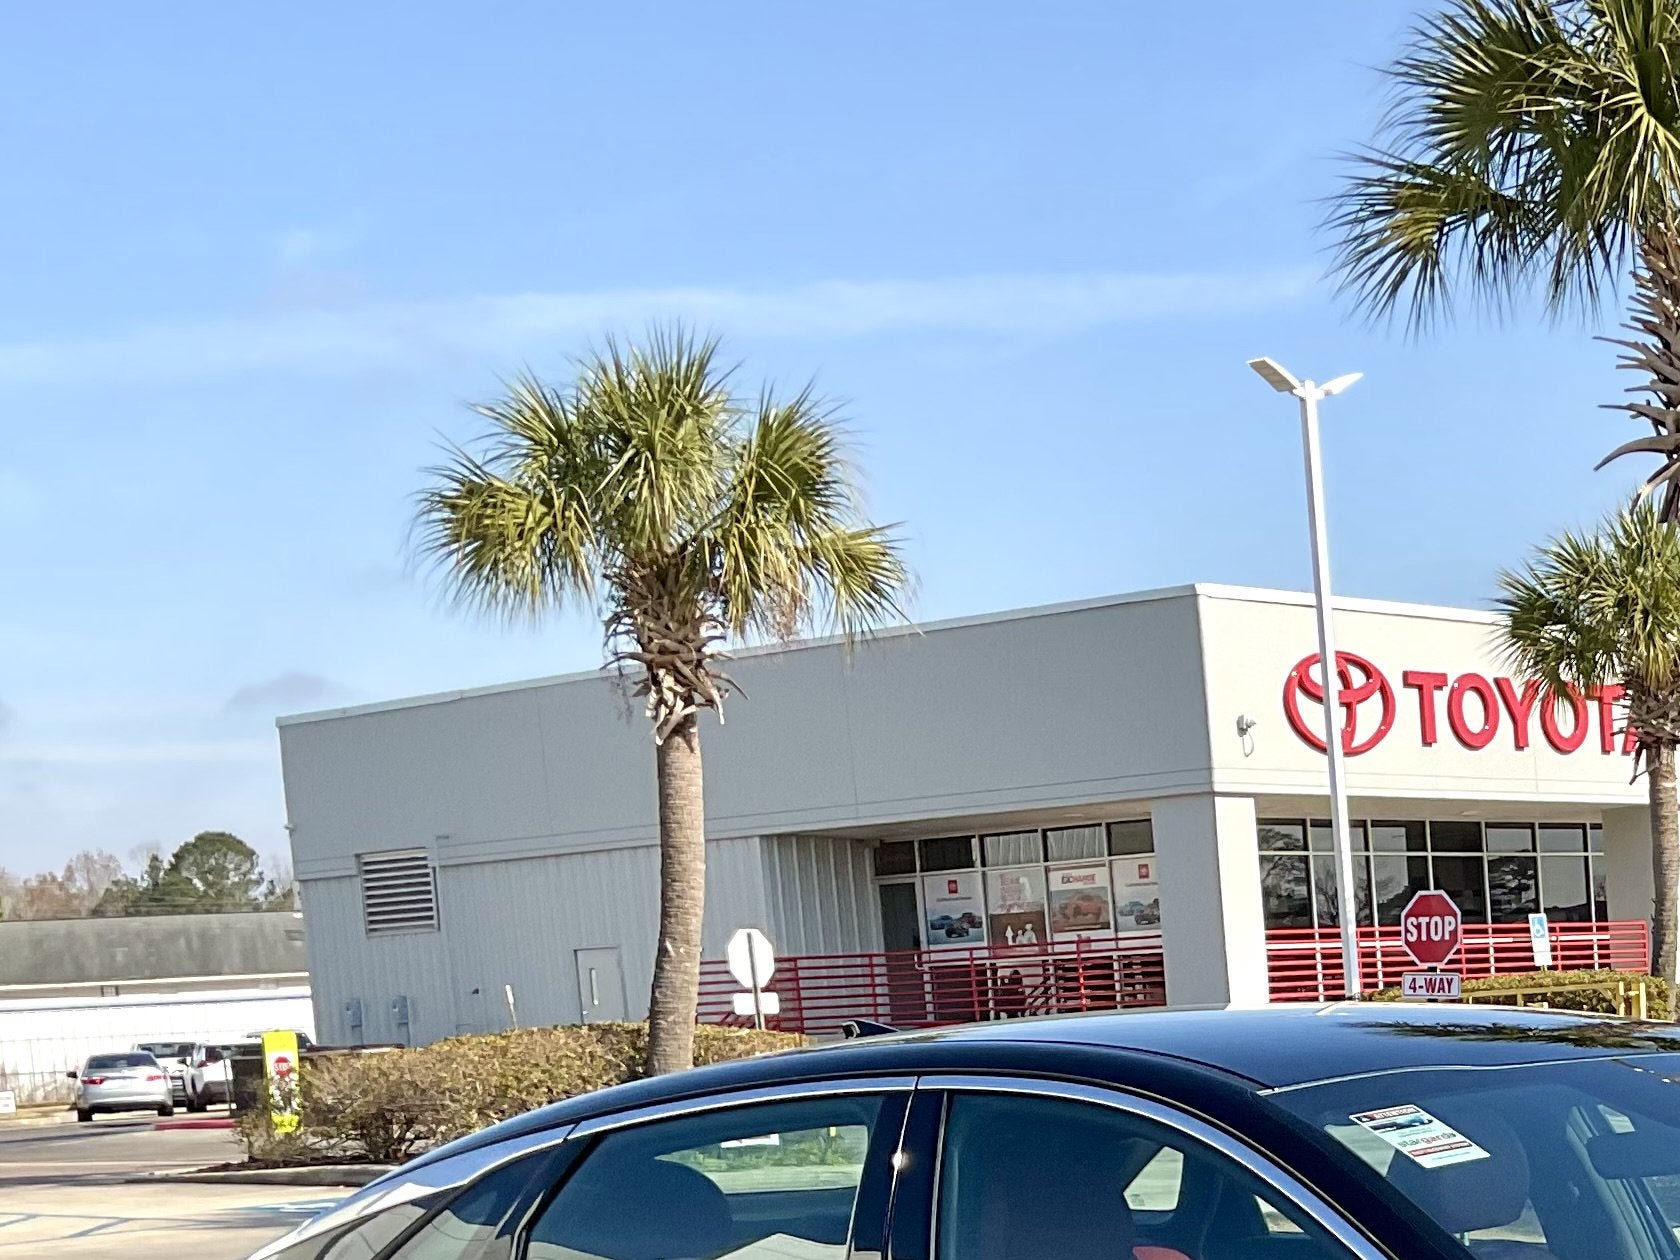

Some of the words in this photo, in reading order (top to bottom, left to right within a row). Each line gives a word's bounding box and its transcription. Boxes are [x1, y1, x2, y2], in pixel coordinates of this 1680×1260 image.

[1402, 670, 1640, 755] TOYOT
[1406, 916, 1456, 942] STOP
[1409, 977, 1454, 994] 4-WAY
